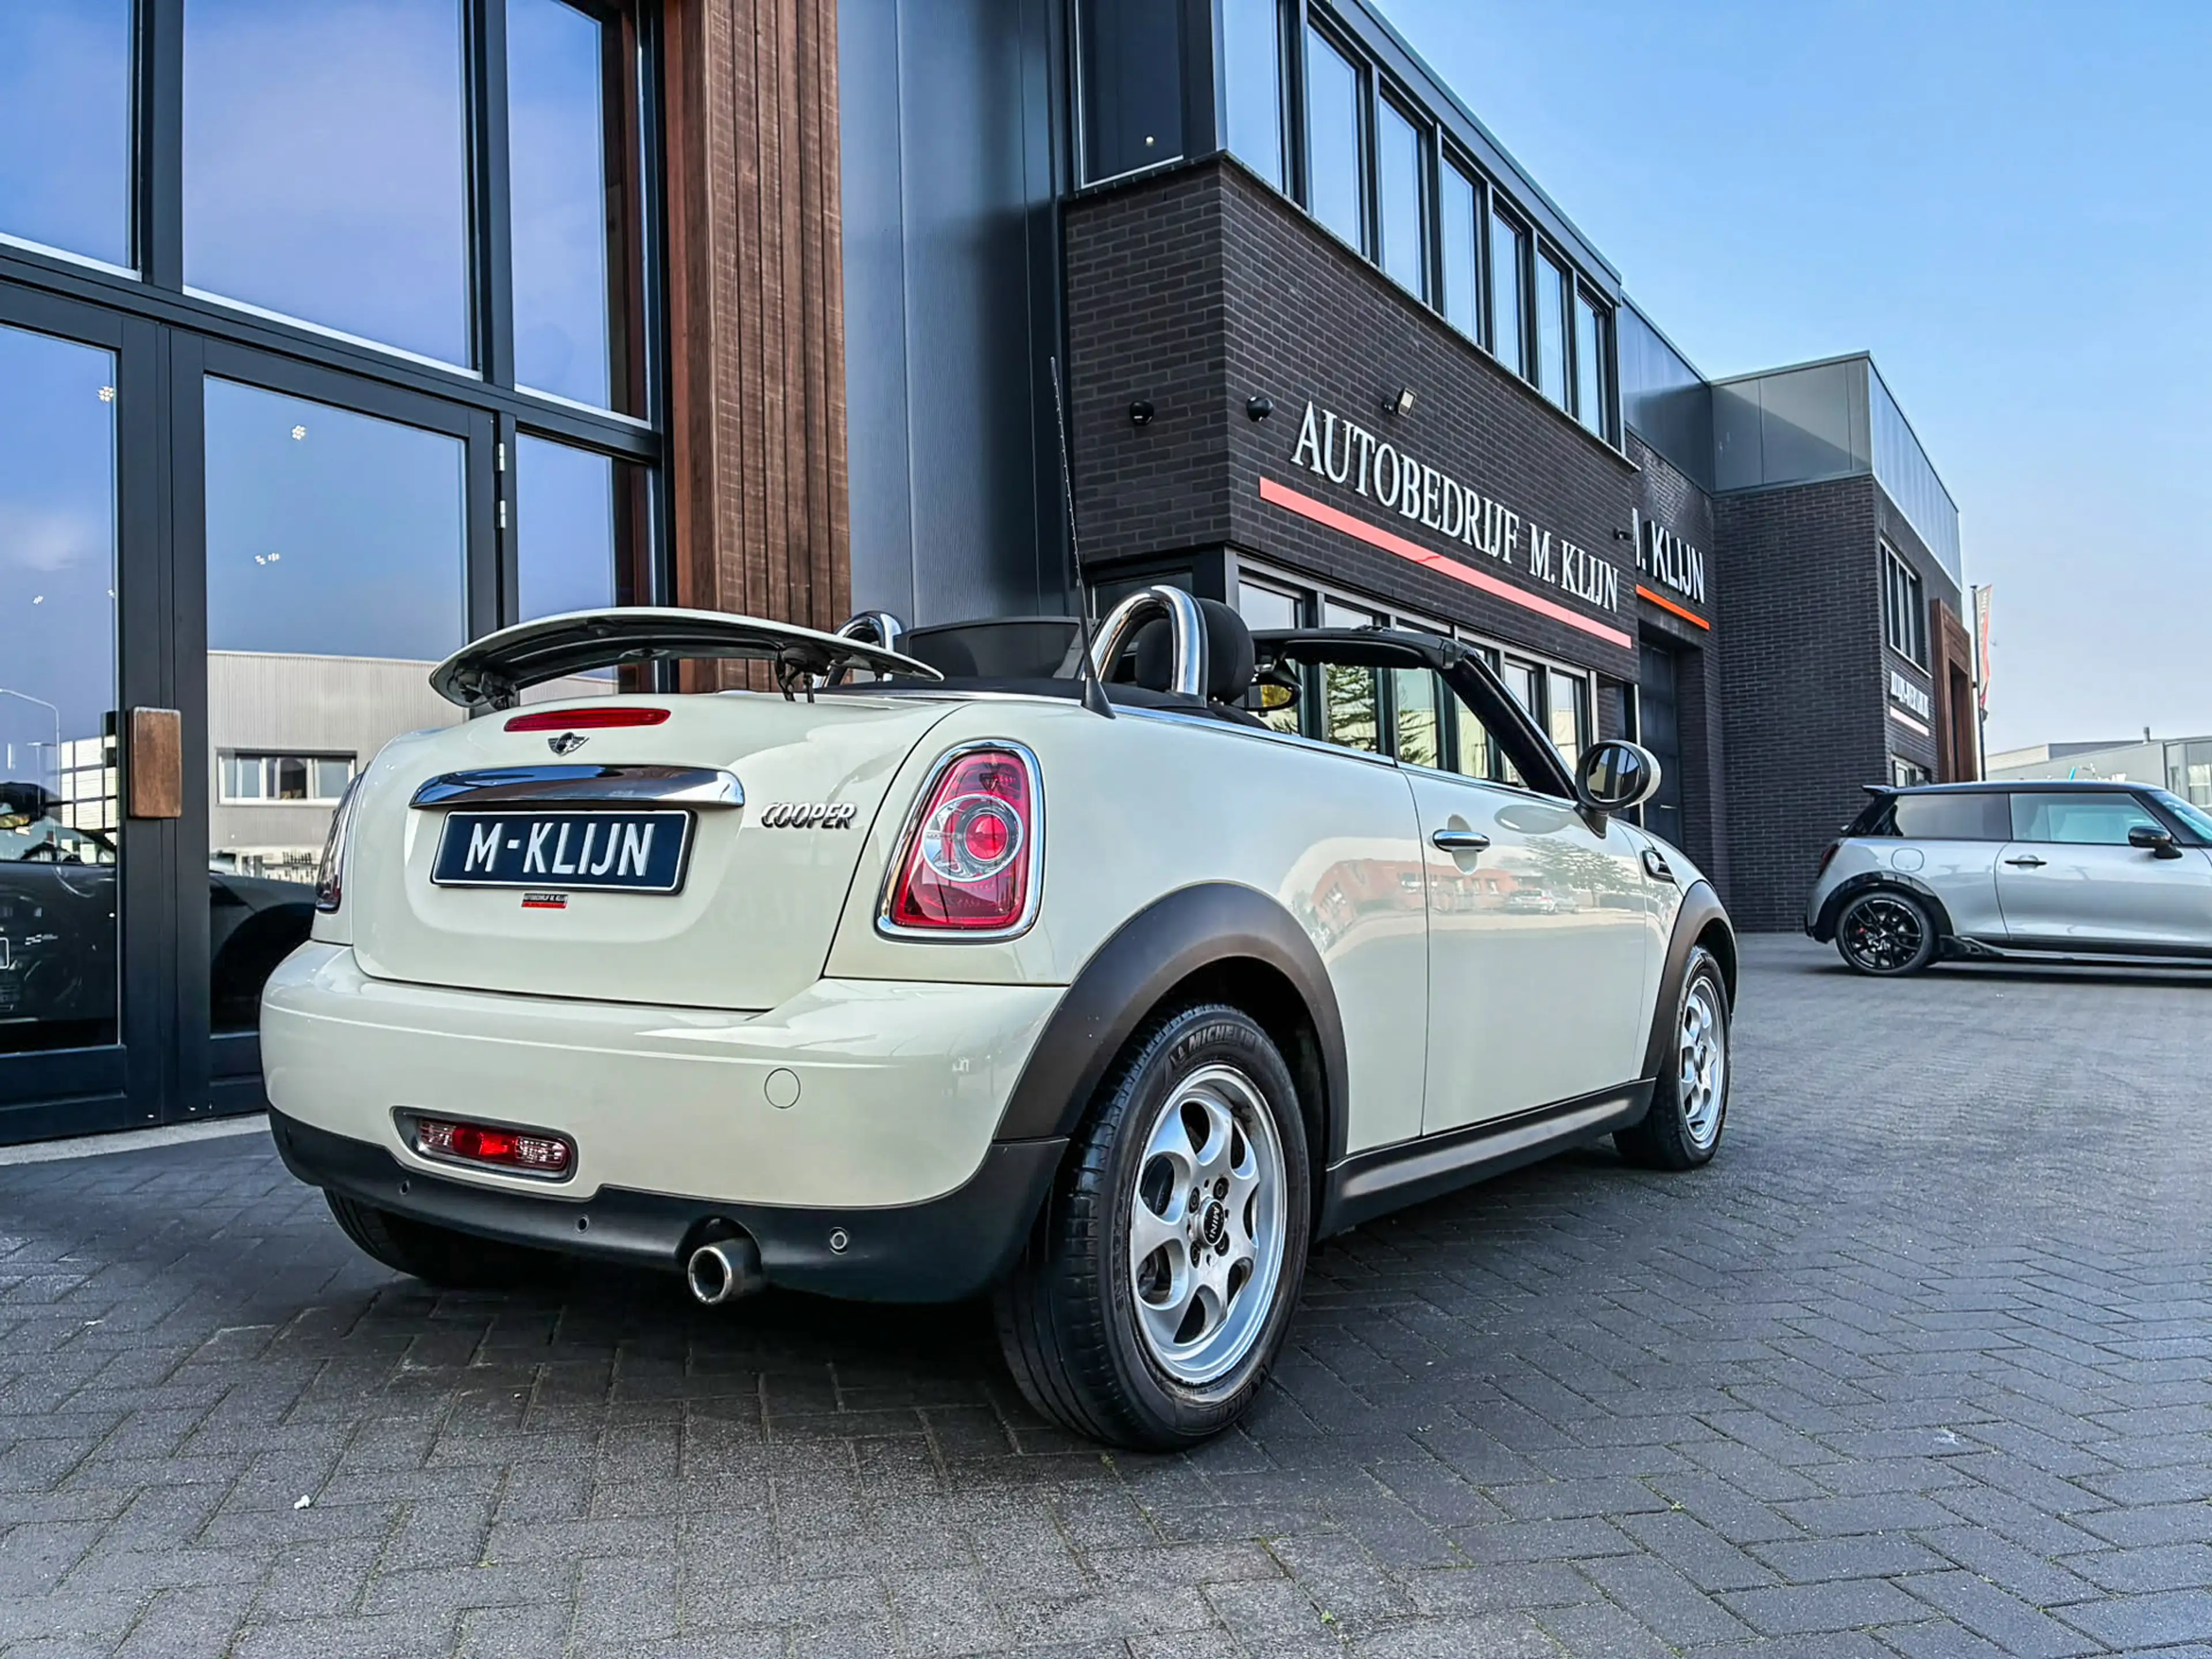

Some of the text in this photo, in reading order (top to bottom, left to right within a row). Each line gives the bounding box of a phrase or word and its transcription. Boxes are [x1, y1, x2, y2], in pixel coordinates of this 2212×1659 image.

[1291, 401, 1619, 613] AUTOBEDRIJF M. KLIJN
[1650, 520, 1705, 604] KLIJN
[761, 801, 856, 830] COOPER
[464, 823, 654, 876] M-KLIJN
[1188, 1025, 1256, 1051] MICHELIN
[1209, 1205, 1220, 1238] MINI
